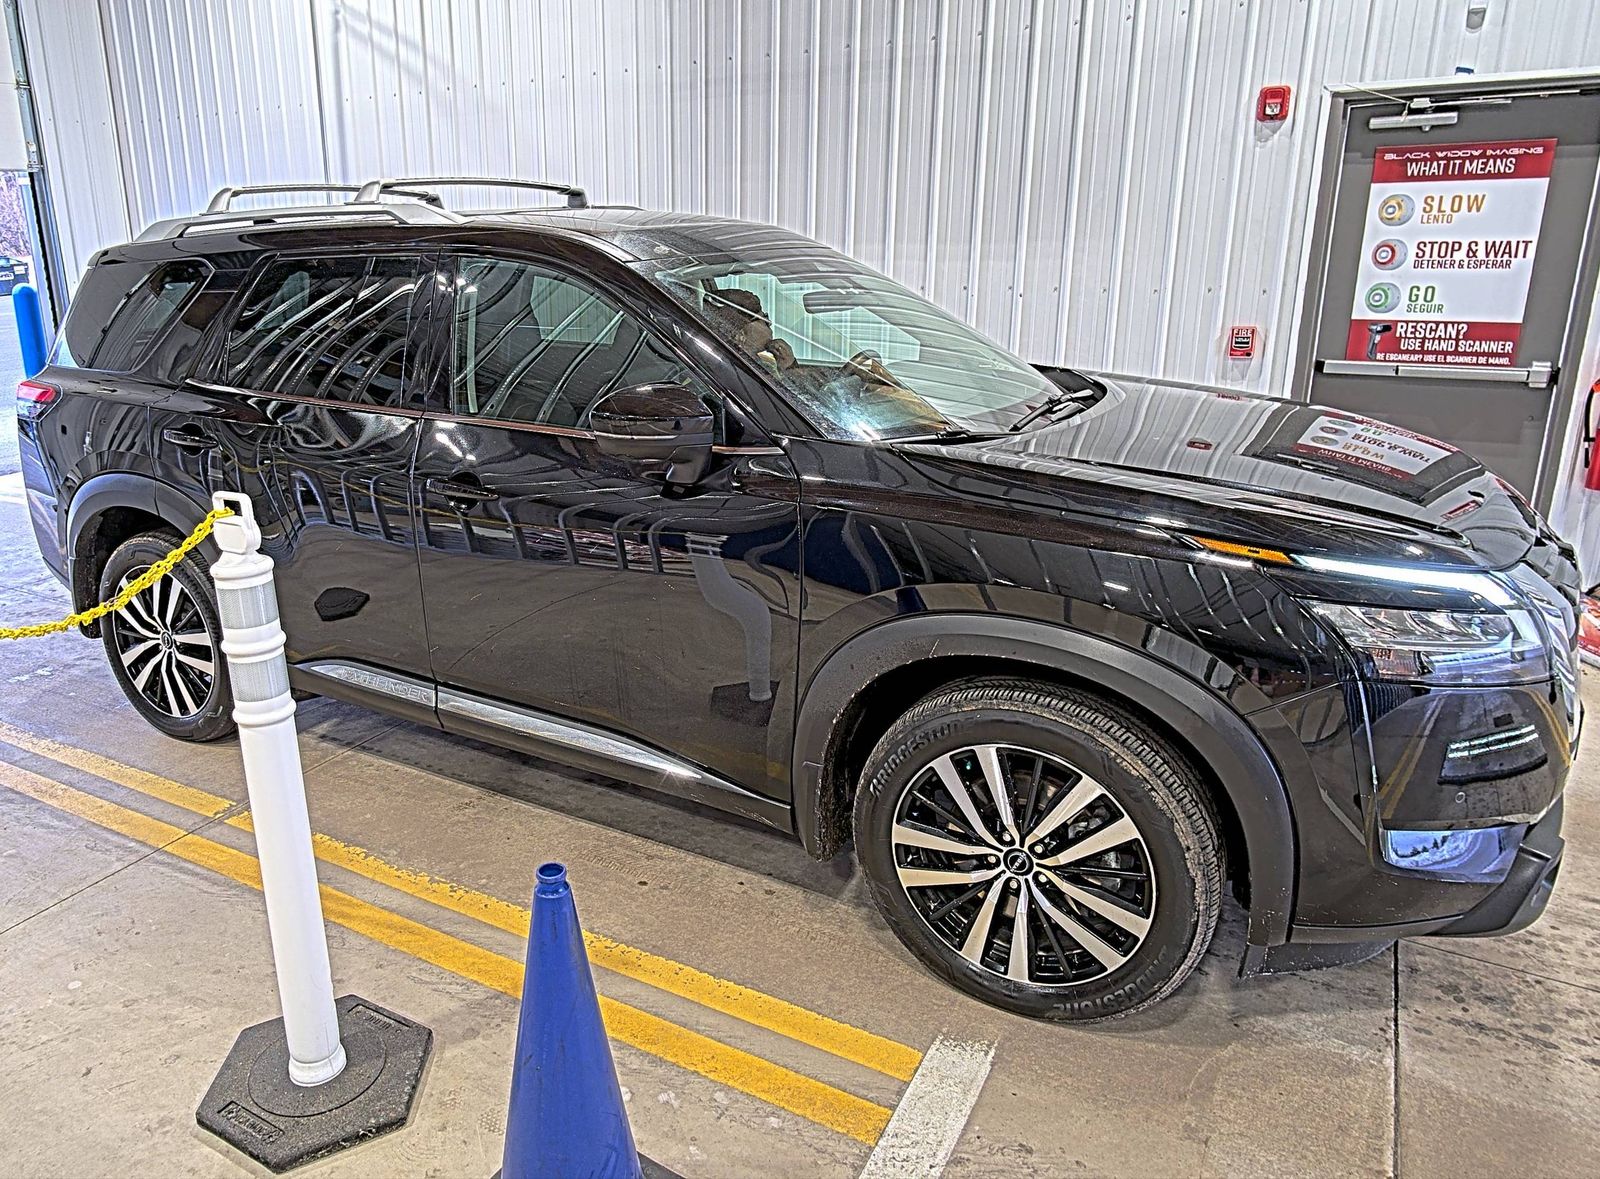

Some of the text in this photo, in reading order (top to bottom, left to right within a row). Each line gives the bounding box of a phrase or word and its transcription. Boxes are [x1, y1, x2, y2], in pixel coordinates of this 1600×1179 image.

[1384, 147, 1544, 160] BLACK WIDOW IMAGING
[1406, 158, 1516, 177] WHAT IT MEANS
[1422, 194, 1486, 214] SLOW
[1420, 214, 1453, 224] LENTO
[1415, 240, 1533, 259] STOP & WAIT
[1413, 259, 1511, 270] DETENER & ESPERAR
[1408, 285, 1436, 303] GO
[1406, 303, 1444, 313] SEGUIR
[1233, 329, 1253, 337] FIRE
[1396, 322, 1468, 339] RESCAN?
[1400, 338, 1514, 354] USE HAND SCANNER
[1376, 353, 1385, 361] RE
[1386, 353, 1423, 362] ESCANEAR?
[1423, 354, 1437, 362] USE
[1437, 355, 1446, 363] EL
[1446, 355, 1477, 364] SCANNER
[1478, 356, 1487, 365] DE
